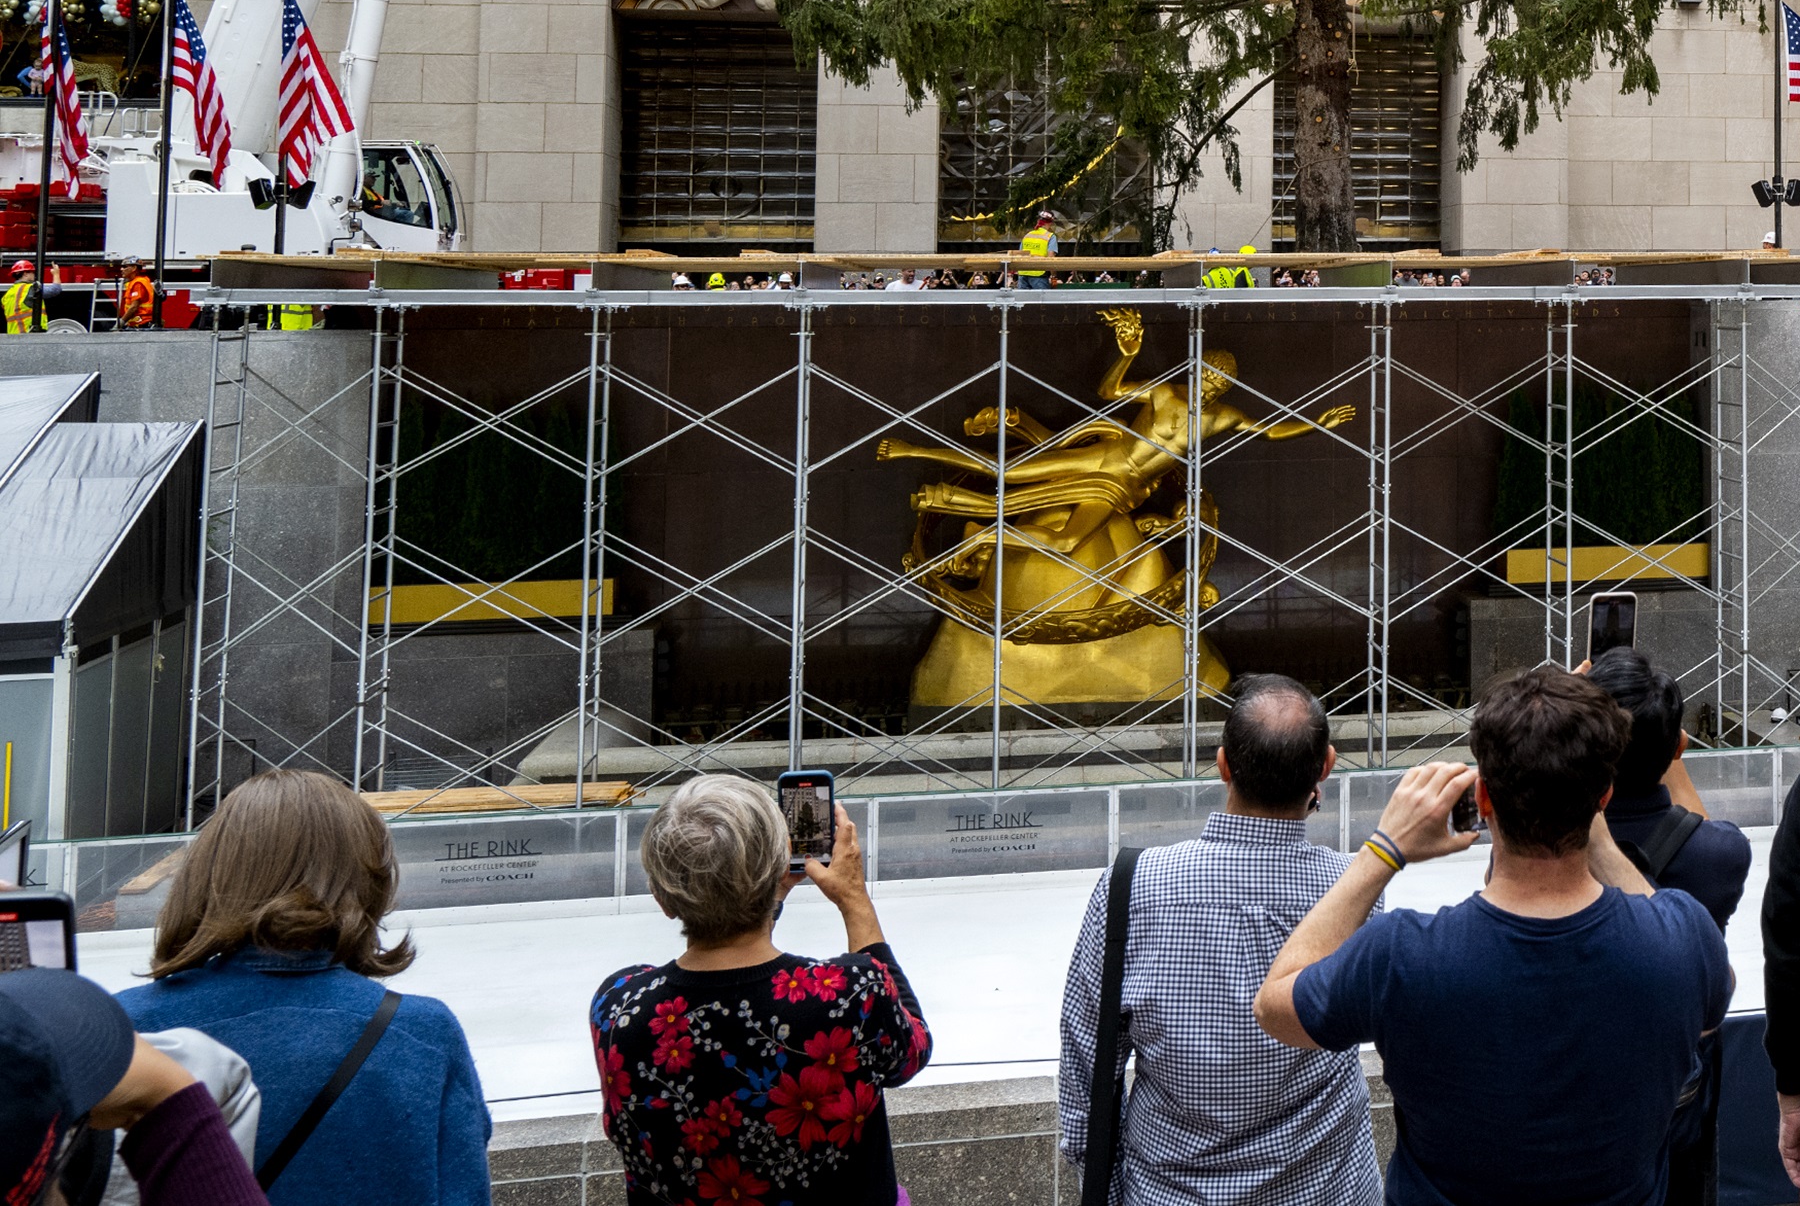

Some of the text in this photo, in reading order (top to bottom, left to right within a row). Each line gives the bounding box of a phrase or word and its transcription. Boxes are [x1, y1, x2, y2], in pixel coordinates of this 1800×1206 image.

[727, 315, 856, 325] PROED
[955, 811, 1034, 831] THE RINK
[961, 834, 1009, 843] ROCKEFELLER
[445, 838, 532, 859] THE RINK
[992, 844, 1036, 852] COACH
[451, 862, 504, 873] ROCKEFELLER
[440, 876, 475, 884] Presented
[486, 873, 534, 882] COACH
